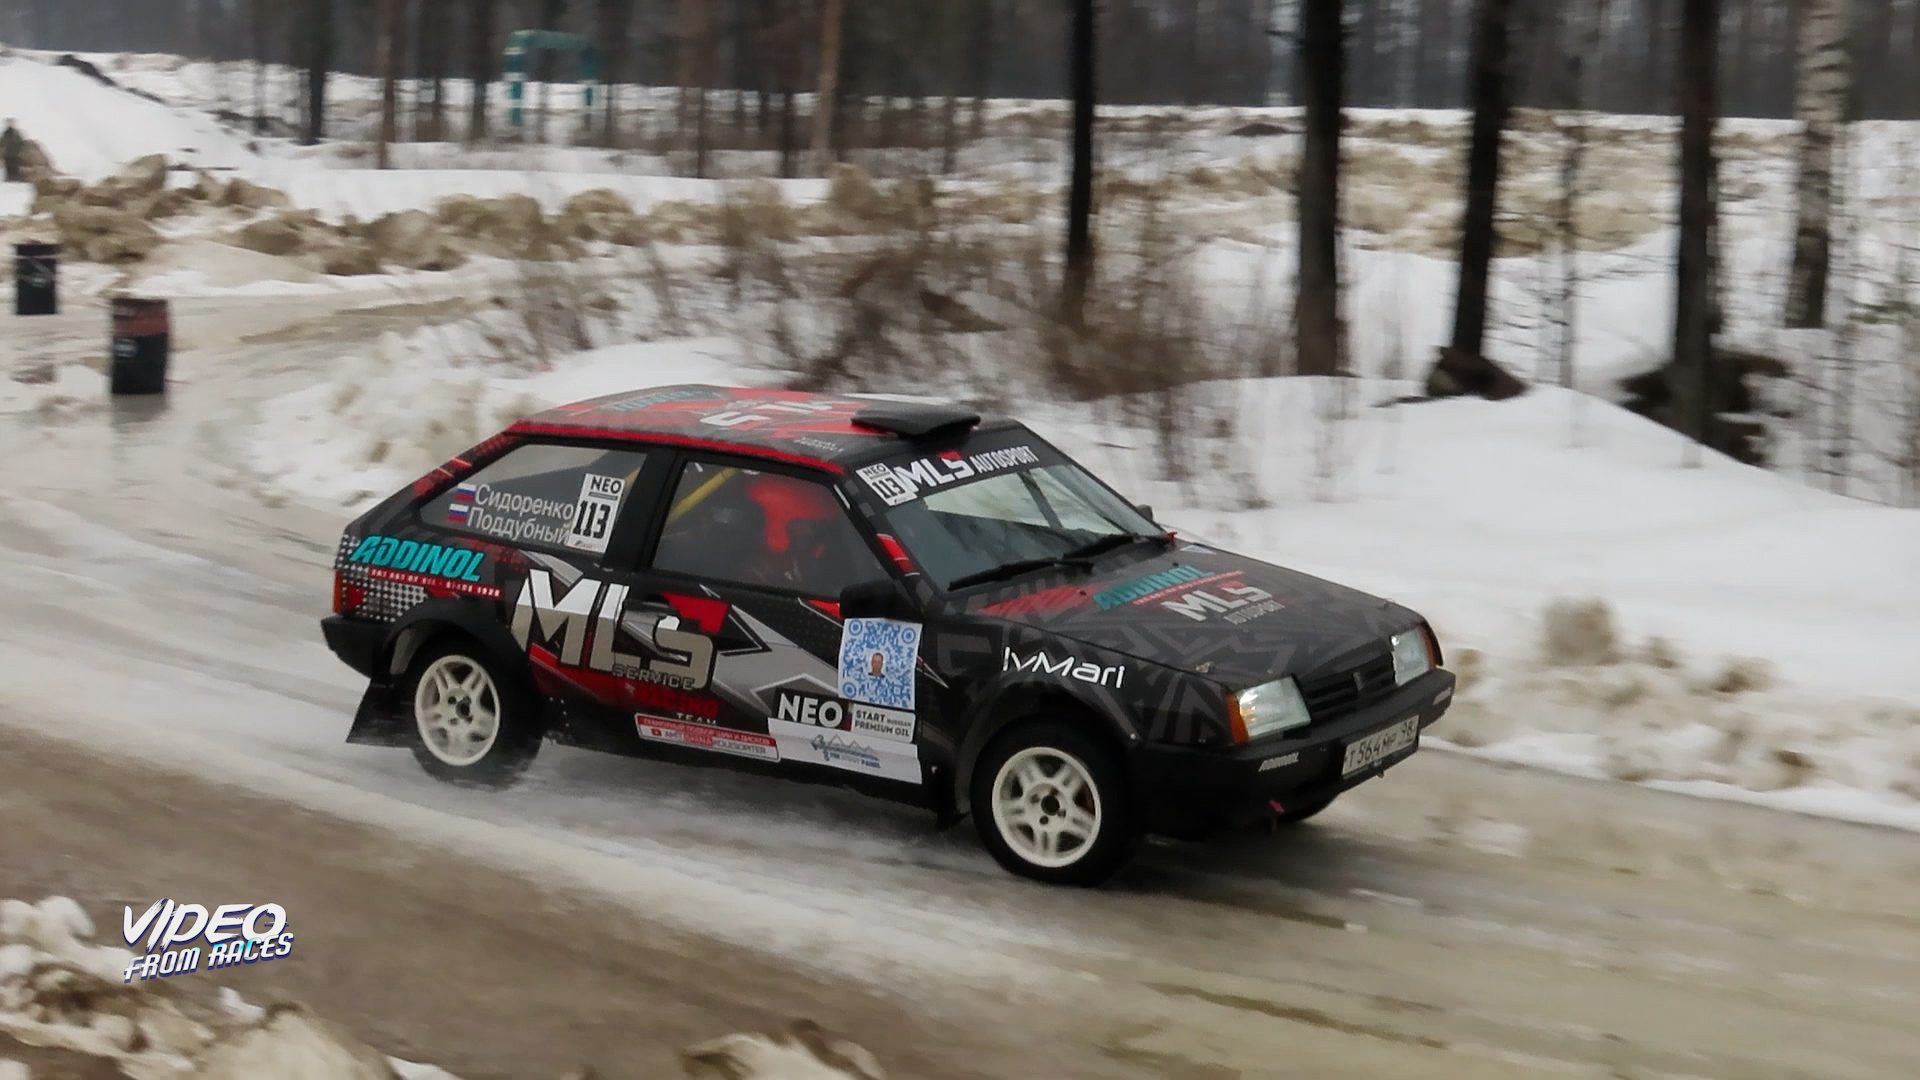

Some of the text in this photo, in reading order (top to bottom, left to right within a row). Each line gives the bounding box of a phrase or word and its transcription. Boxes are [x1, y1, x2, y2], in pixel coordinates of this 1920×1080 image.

[590, 476, 622, 493] NEO
[863, 463, 887, 477] NEO
[894, 446, 1040, 492] MLS AUTOSPORT
[475, 484, 574, 521] Сидоренко
[872, 477, 906, 499] 113
[467, 507, 571, 546] Поддубный
[572, 500, 611, 540] 113
[350, 535, 485, 582] ADDINOL
[1160, 581, 1273, 622] MLS
[511, 569, 727, 689] MLS
[612, 665, 695, 690] SERVICE
[676, 712, 717, 725] TEAM
[778, 692, 843, 728] NEO
[856, 710, 886, 723] START
[854, 720, 911, 737] PREMIUM OIL
